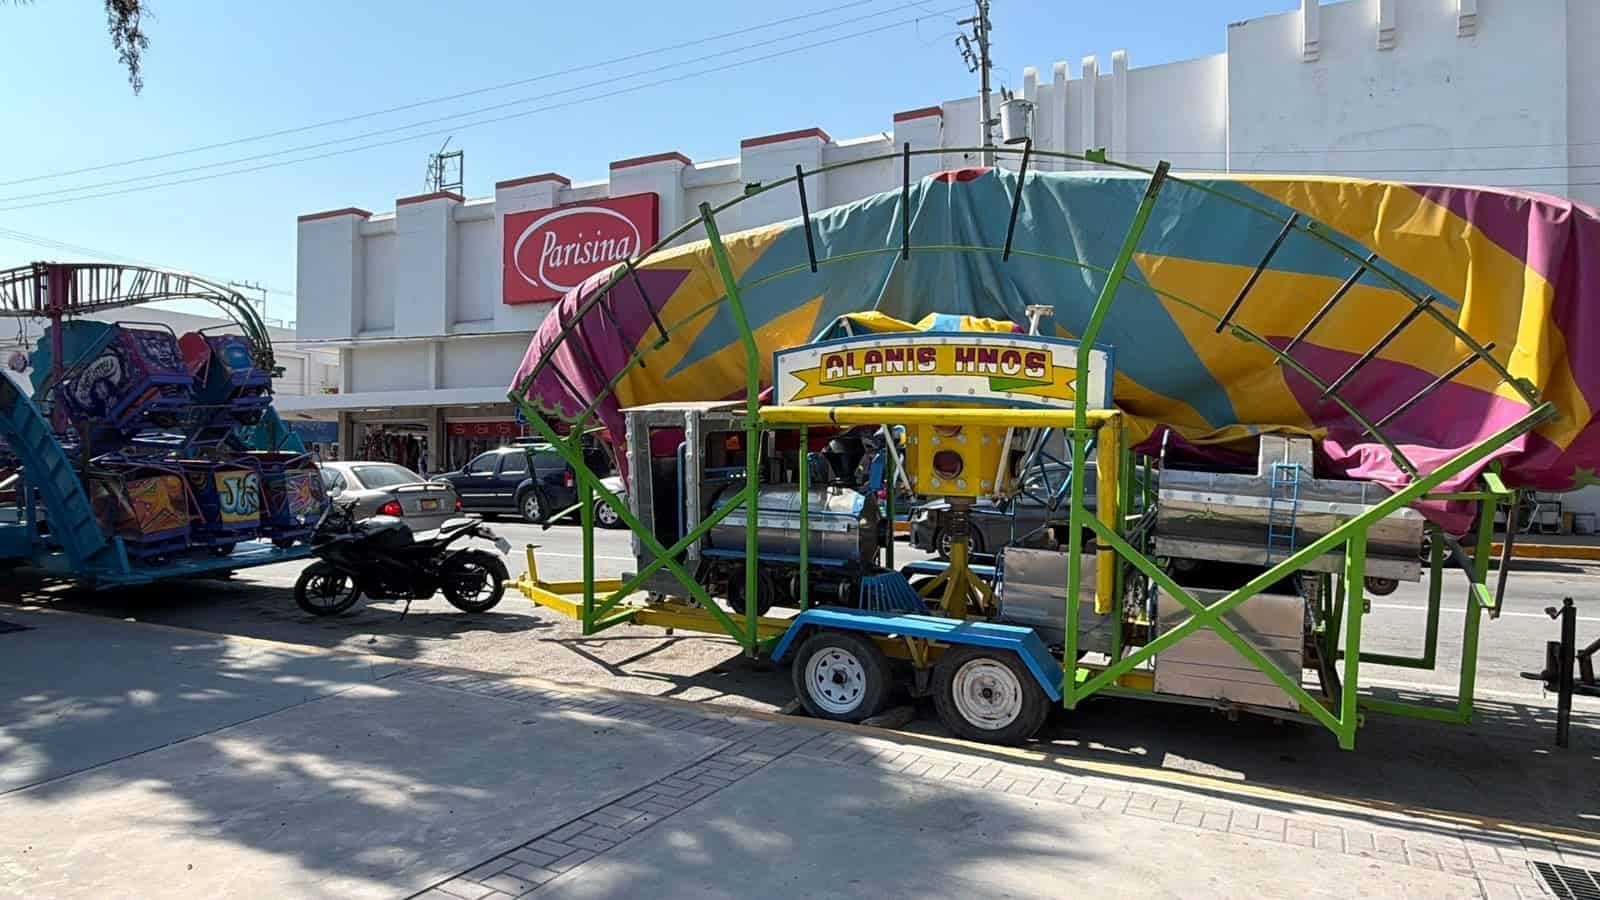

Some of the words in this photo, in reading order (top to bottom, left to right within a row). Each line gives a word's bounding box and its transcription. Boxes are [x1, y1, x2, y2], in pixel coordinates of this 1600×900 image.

[539, 229, 632, 270] Parisina
[825, 347, 937, 379] ALANIS
[955, 348, 1047, 377] HNOS
